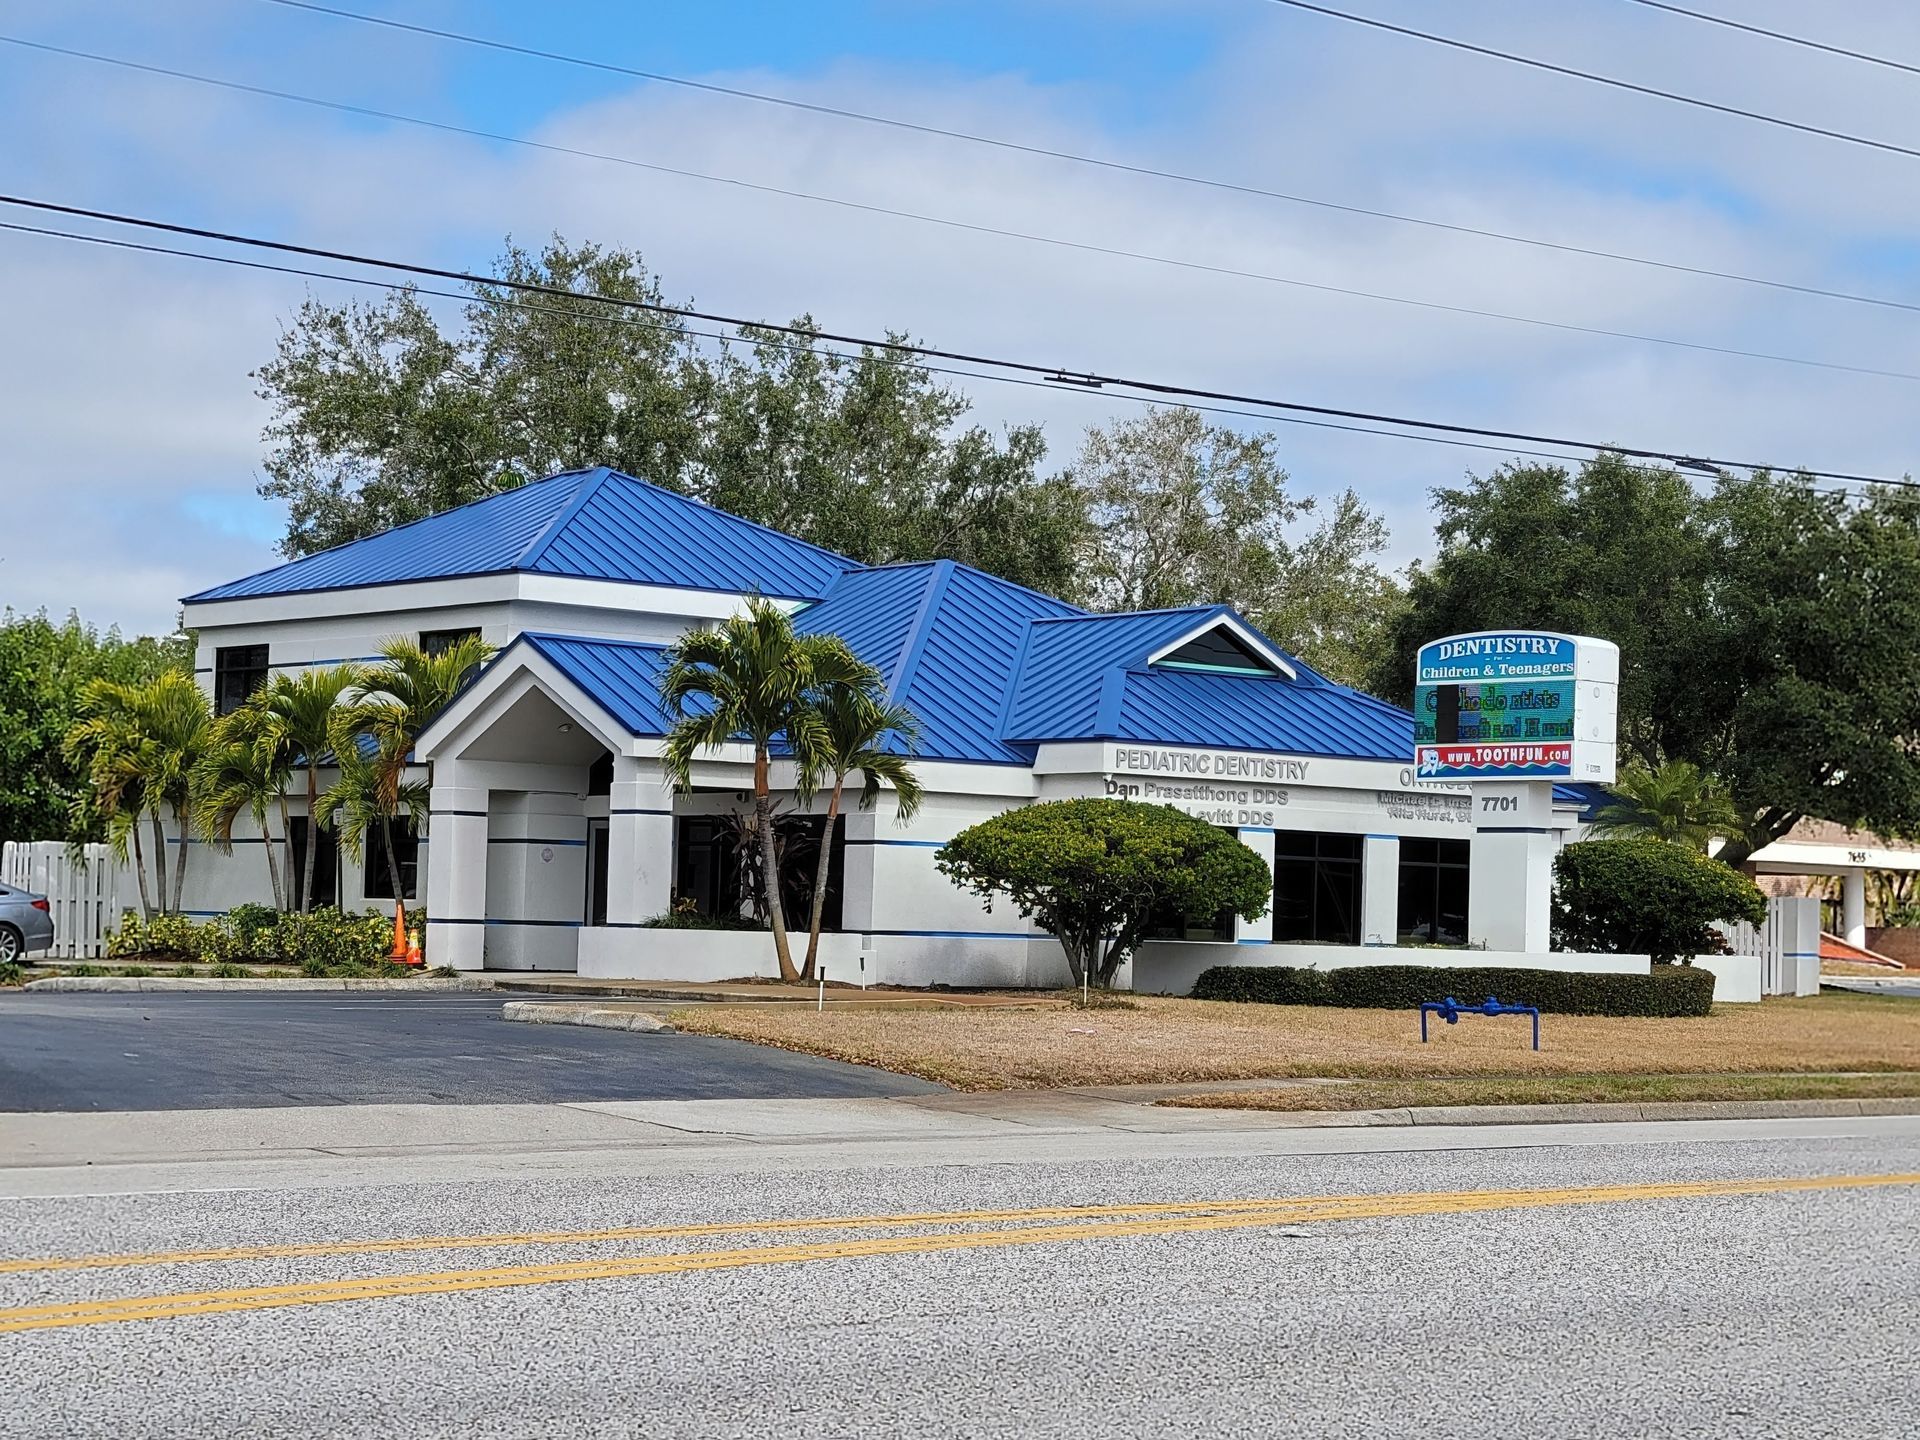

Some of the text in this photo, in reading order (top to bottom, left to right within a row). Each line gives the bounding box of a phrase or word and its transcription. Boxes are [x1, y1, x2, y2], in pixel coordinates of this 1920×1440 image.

[1439, 637, 1560, 660] DENTISTRY
[1422, 662, 1574, 679] Children & Teenagers
[1115, 749, 1310, 780] PEDIATRIC DENTISTRY
[1106, 780, 1289, 805] Dan Prasatthong DDS
[1378, 792, 1428, 806] Michael
[1481, 796, 1518, 811] 7701
[1238, 809, 1275, 826] DDS
[1387, 807, 1414, 820] Rita
